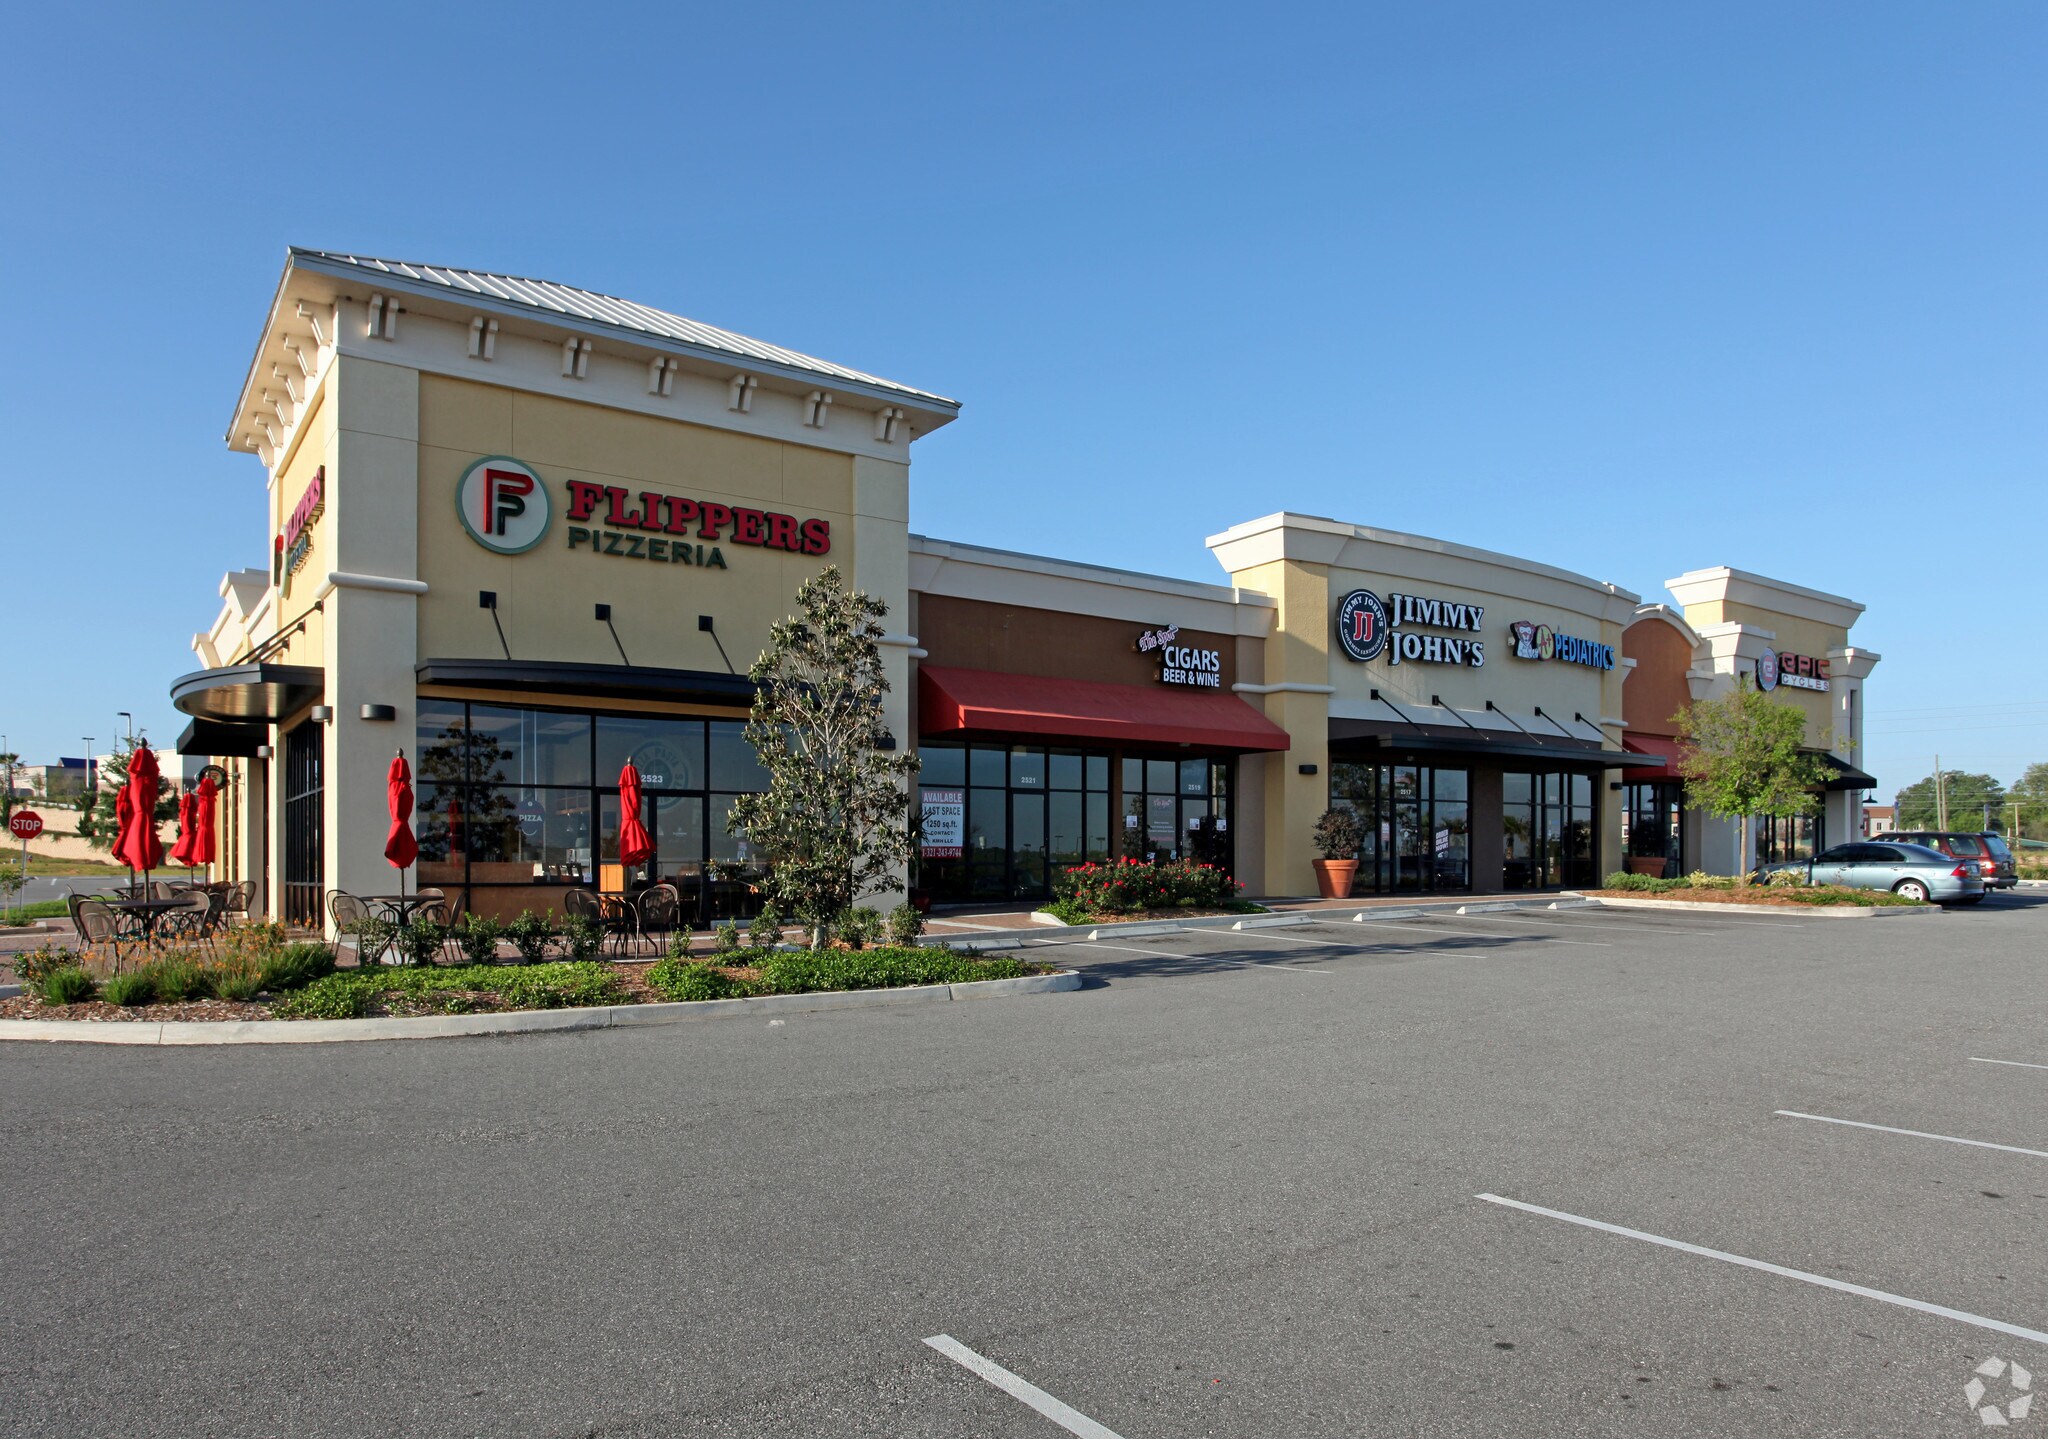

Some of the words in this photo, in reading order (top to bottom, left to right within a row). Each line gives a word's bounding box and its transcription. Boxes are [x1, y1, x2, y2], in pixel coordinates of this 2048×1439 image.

[566, 480, 831, 555] FLIPPERS
[568, 526, 728, 569] PIZZERIA
[1343, 596, 1362, 623] JIMMY
[1364, 597, 1384, 627] JOHN'S
[1389, 593, 1484, 631] JIMMY
[1353, 610, 1374, 641] JJ
[1139, 631, 1157, 652] The
[1389, 632, 1485, 667] JOHN'S
[1554, 633, 1615, 671] PEDIATRICS
[1164, 646, 1220, 672] CIGARS
[1163, 668, 1186, 684] BEER
[1188, 671, 1195, 685] &
[1196, 671, 1220, 687] WINE
[1782, 674, 1830, 690] CYCLES
[641, 774, 663, 783] 2523
[1021, 776, 1036, 784] 2521
[923, 792, 962, 803] AVAILABLE
[924, 806, 940, 815] LAST
[942, 806, 960, 815] SPACE
[12, 819, 41, 831] STOP
